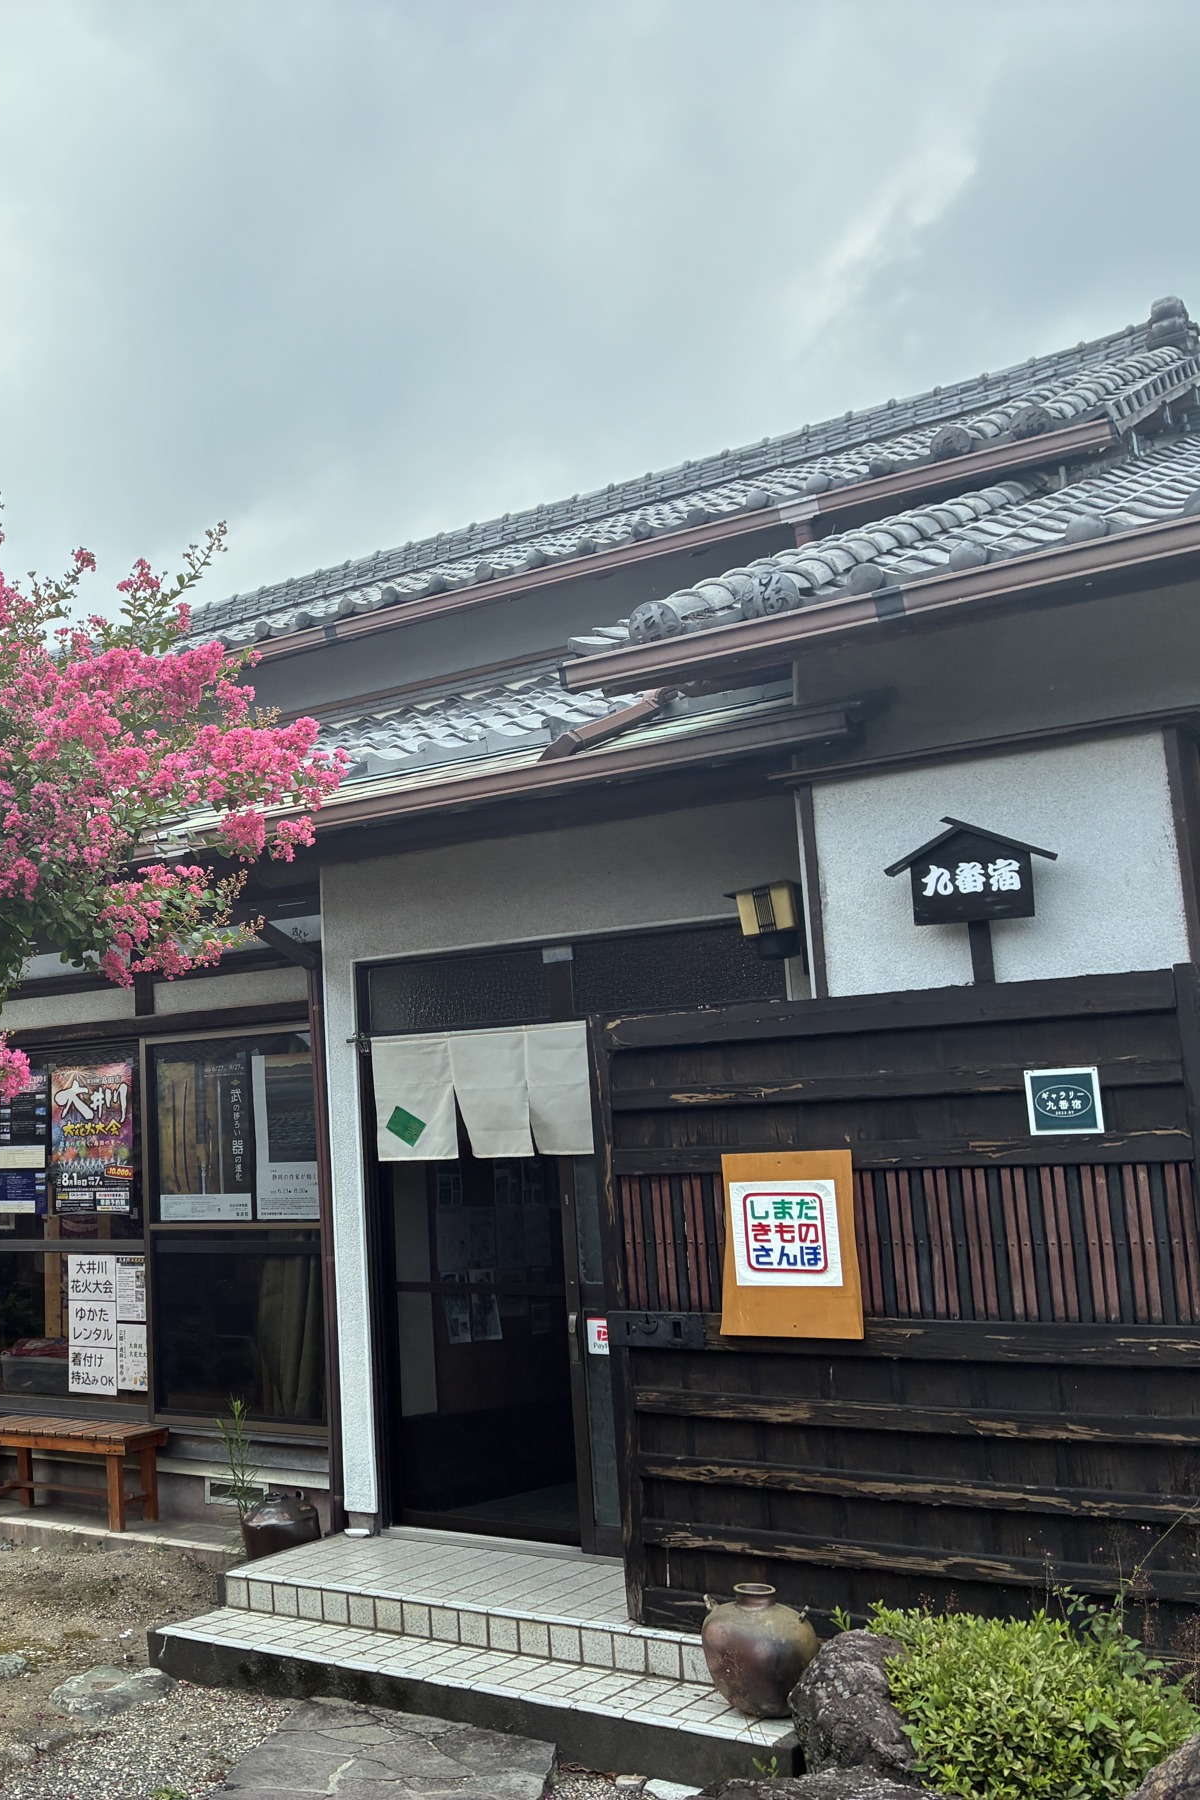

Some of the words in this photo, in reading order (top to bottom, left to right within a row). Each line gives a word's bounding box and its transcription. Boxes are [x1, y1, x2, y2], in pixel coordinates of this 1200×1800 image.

[921, 858, 1022, 897] 九番宿
[54, 1080, 129, 1124] 大井川
[1041, 1090, 1085, 1100] ギャラリー
[1046, 1099, 1082, 1111] 九番宿
[62, 1120, 122, 1138] 大花火大会
[749, 1198, 818, 1221] しまだ
[751, 1222, 820, 1244] きもの
[752, 1244, 822, 1267] さんぽ
[75, 1260, 108, 1275] 大井川
[70, 1279, 113, 1295] 花火大会
[75, 1306, 109, 1322] ゆかた
[73, 1326, 113, 1342] レンタル
[71, 1352, 104, 1368] 着付け
